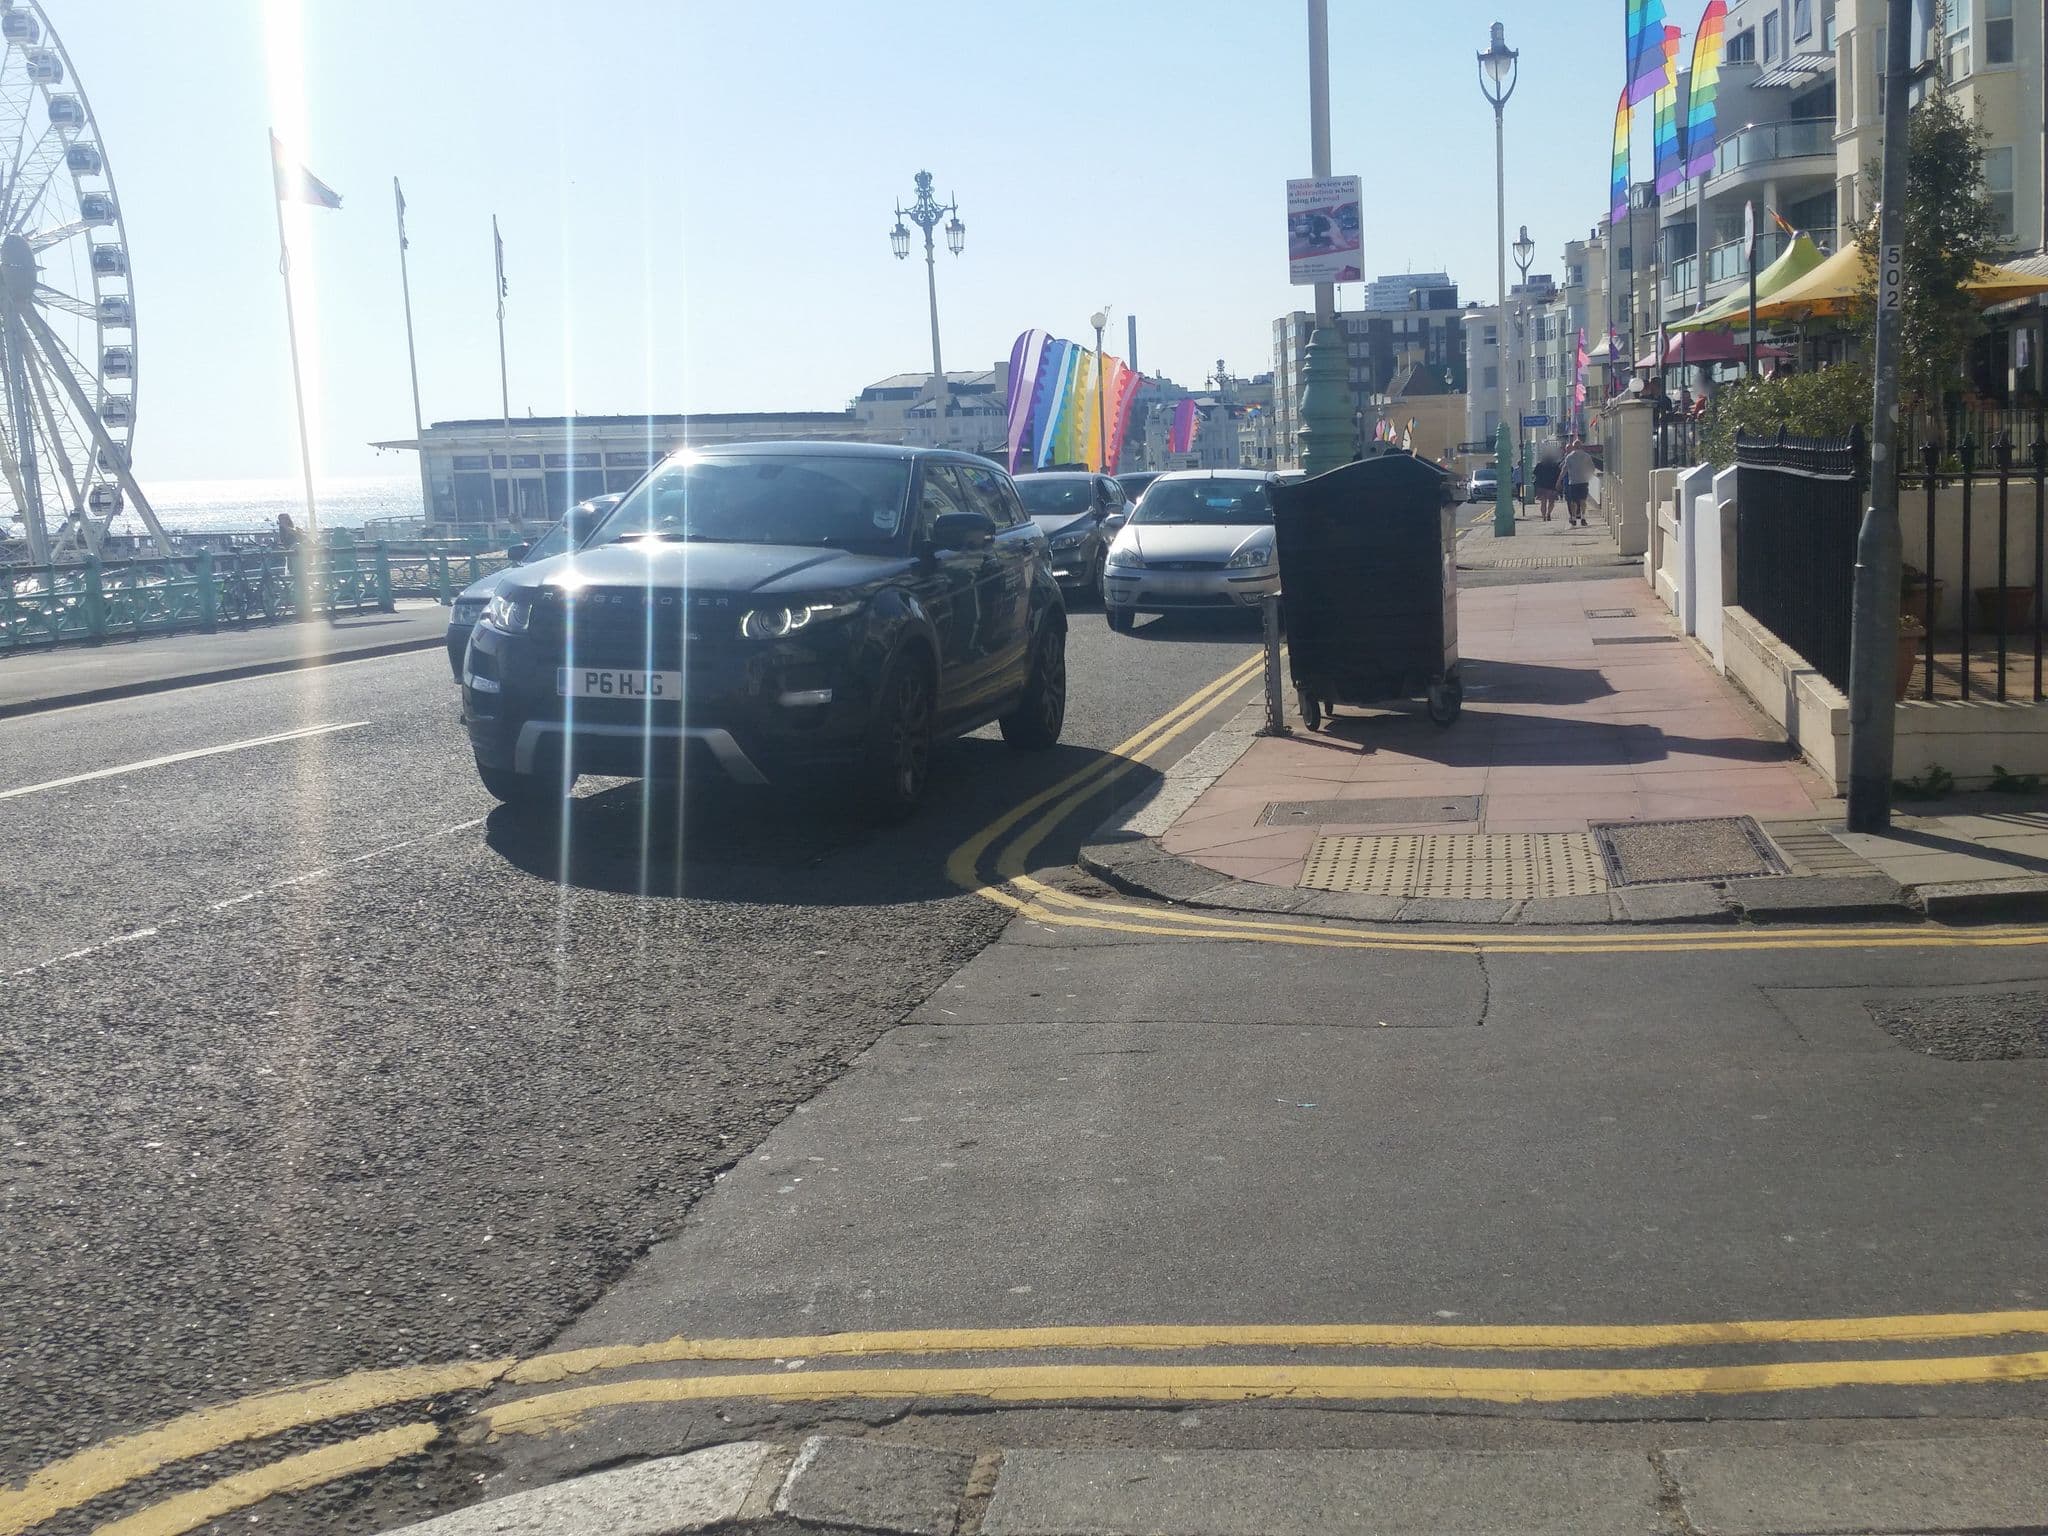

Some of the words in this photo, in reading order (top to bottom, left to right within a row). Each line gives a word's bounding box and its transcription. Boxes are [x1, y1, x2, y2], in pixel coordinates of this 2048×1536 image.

[1887, 248, 1899, 306] 502
[586, 672, 613, 694] P6
[619, 673, 663, 696] HJG
